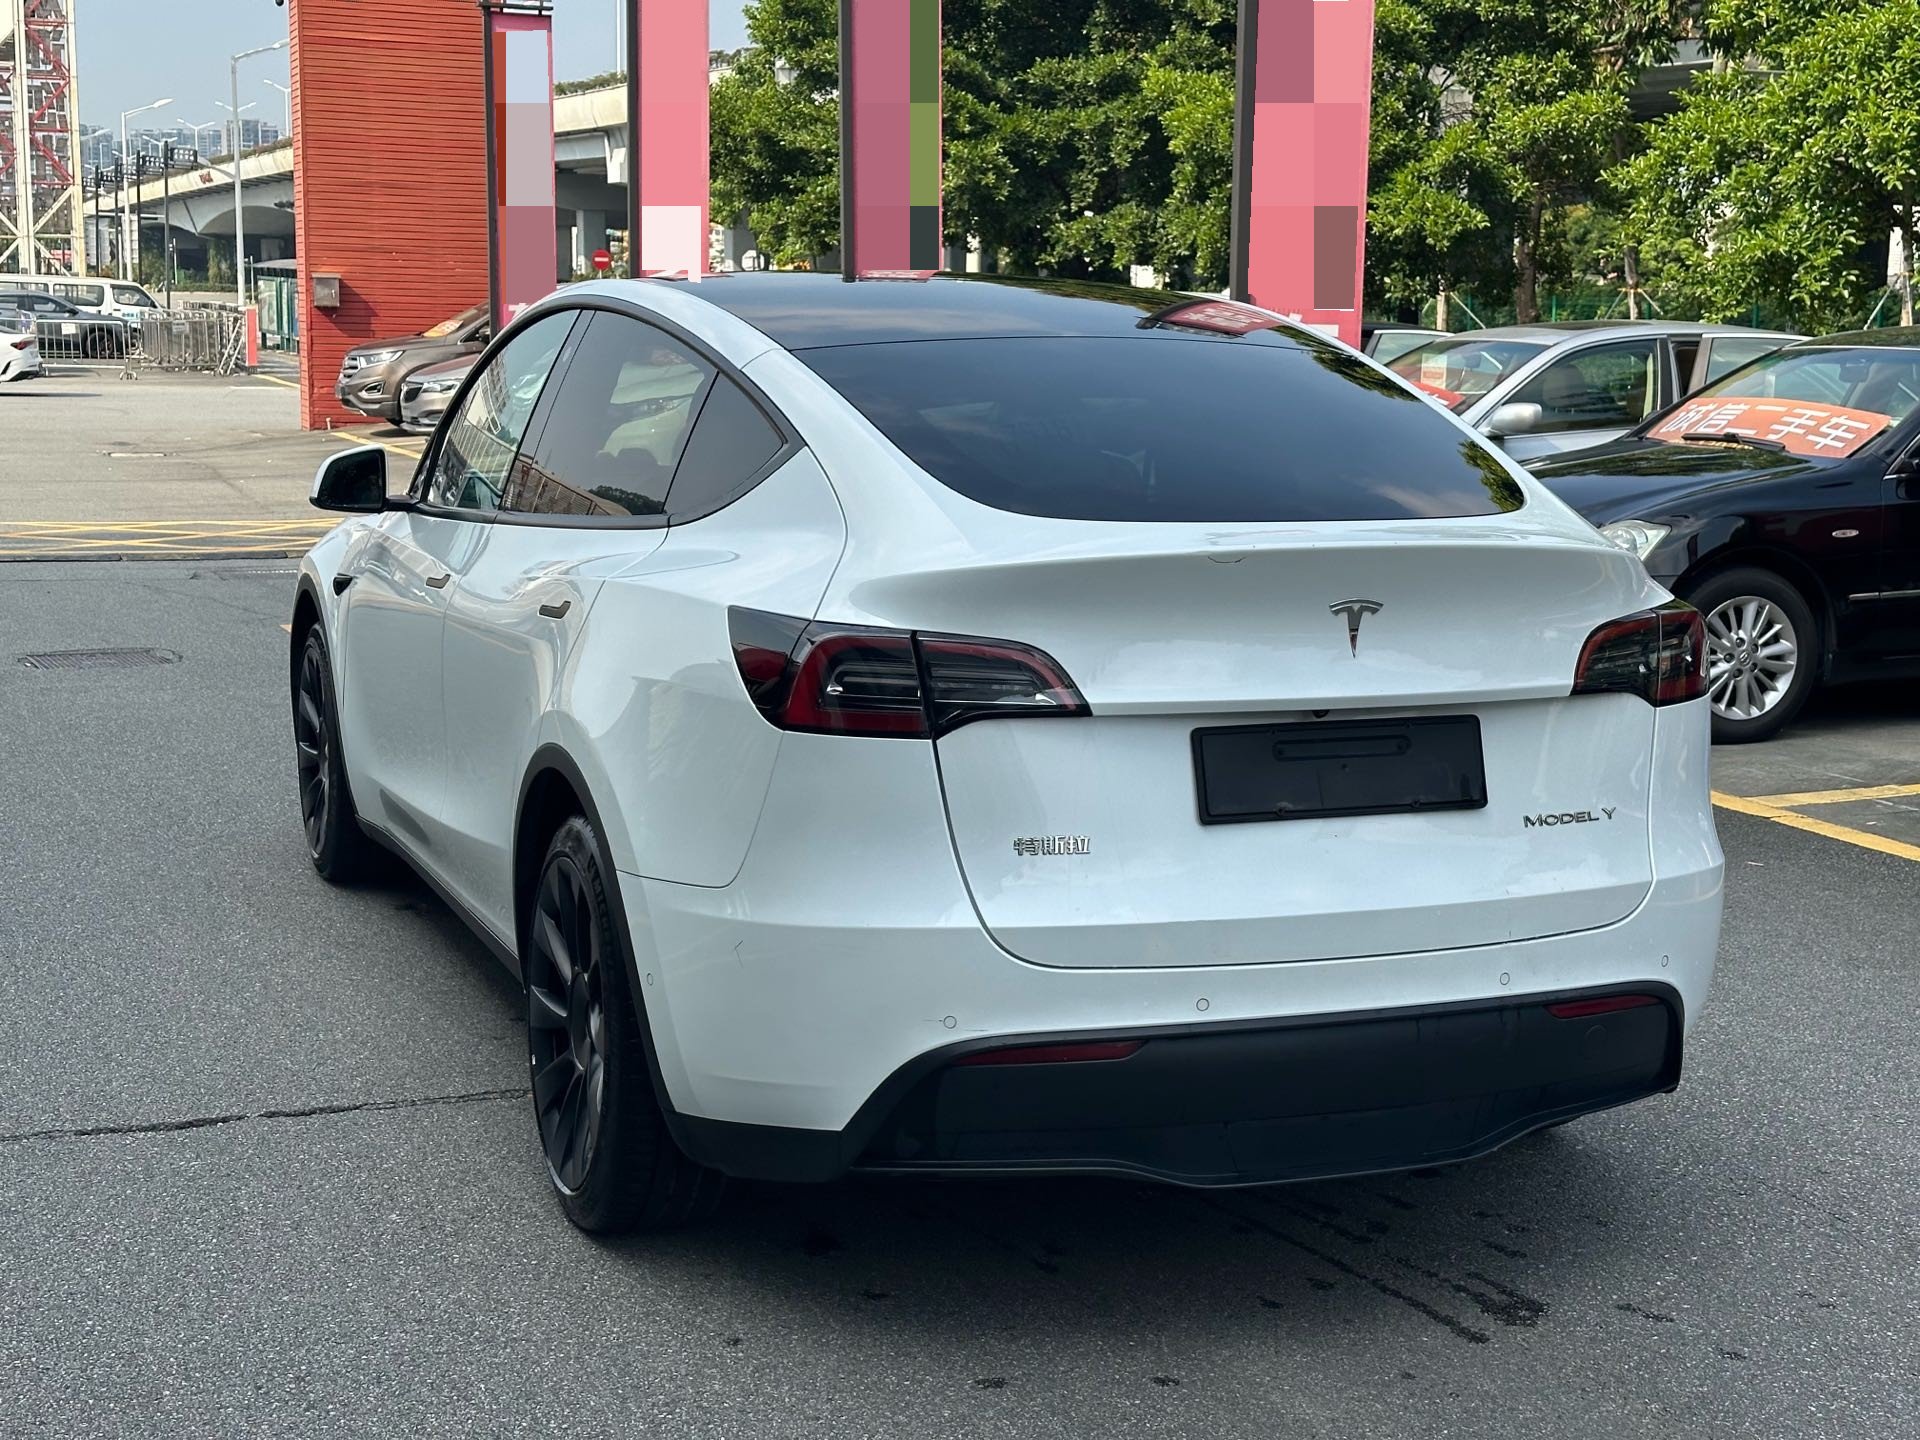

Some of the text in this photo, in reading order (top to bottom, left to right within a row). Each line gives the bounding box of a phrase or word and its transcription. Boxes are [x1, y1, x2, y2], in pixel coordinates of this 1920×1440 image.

[1522, 806, 1617, 828] MODEL Y
[1013, 835, 1091, 856] 特斯拉
